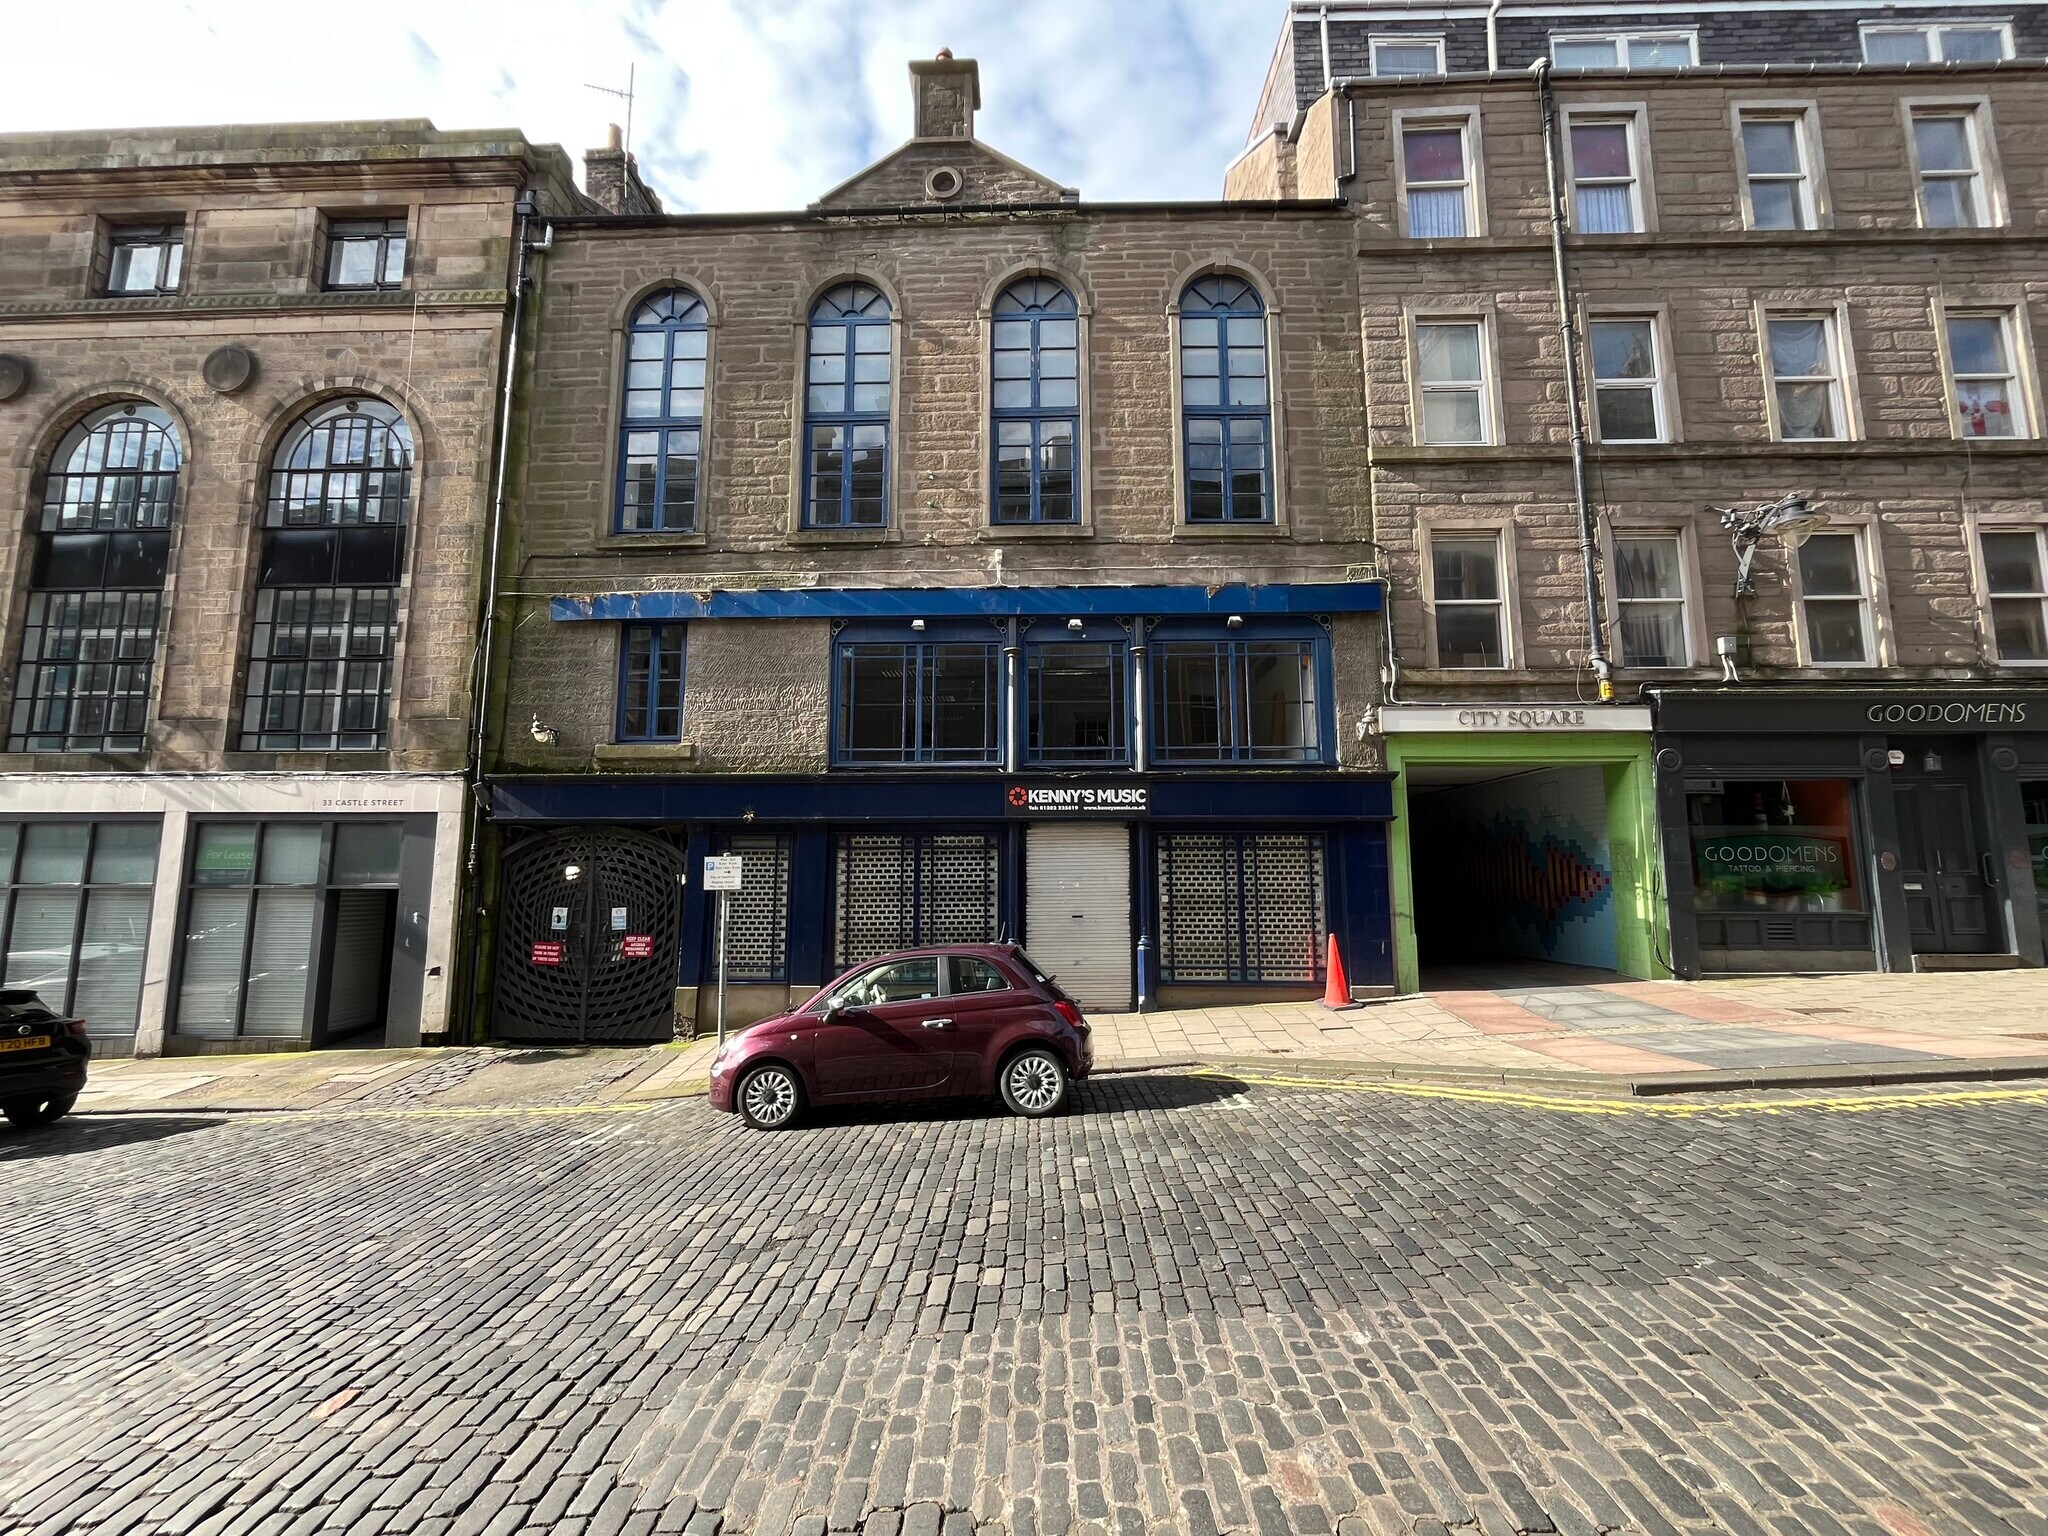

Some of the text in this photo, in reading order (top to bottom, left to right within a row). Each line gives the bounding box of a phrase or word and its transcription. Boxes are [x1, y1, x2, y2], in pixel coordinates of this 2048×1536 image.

[1458, 710, 1585, 728] CITY SQUARE
[1028, 789, 1146, 803] KENNY'S MUSIC
[206, 849, 252, 859] For Lease
[1728, 864, 1762, 872] TATTOO
[24, 1038, 45, 1047] HFB
